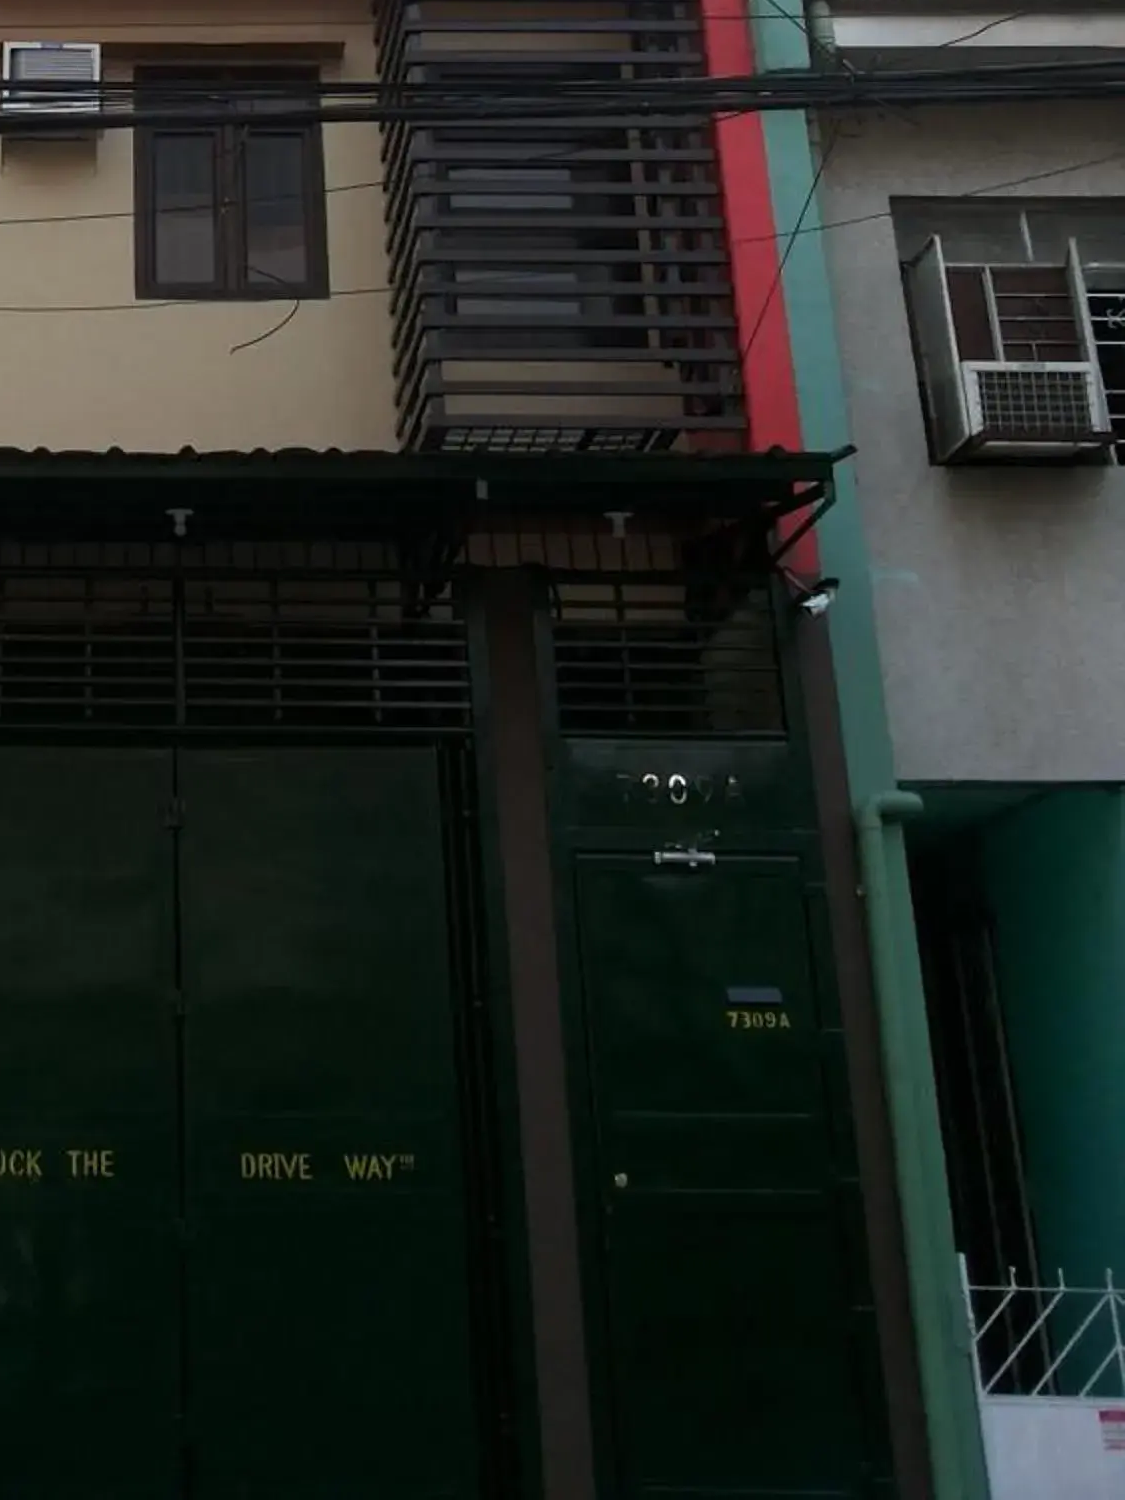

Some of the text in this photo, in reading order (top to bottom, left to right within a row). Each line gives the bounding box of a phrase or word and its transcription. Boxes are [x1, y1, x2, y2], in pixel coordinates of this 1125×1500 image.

[726, 1011, 791, 1029] 7309A
[66, 1149, 115, 1177] THE
[241, 1151, 314, 1180] DRIVE
